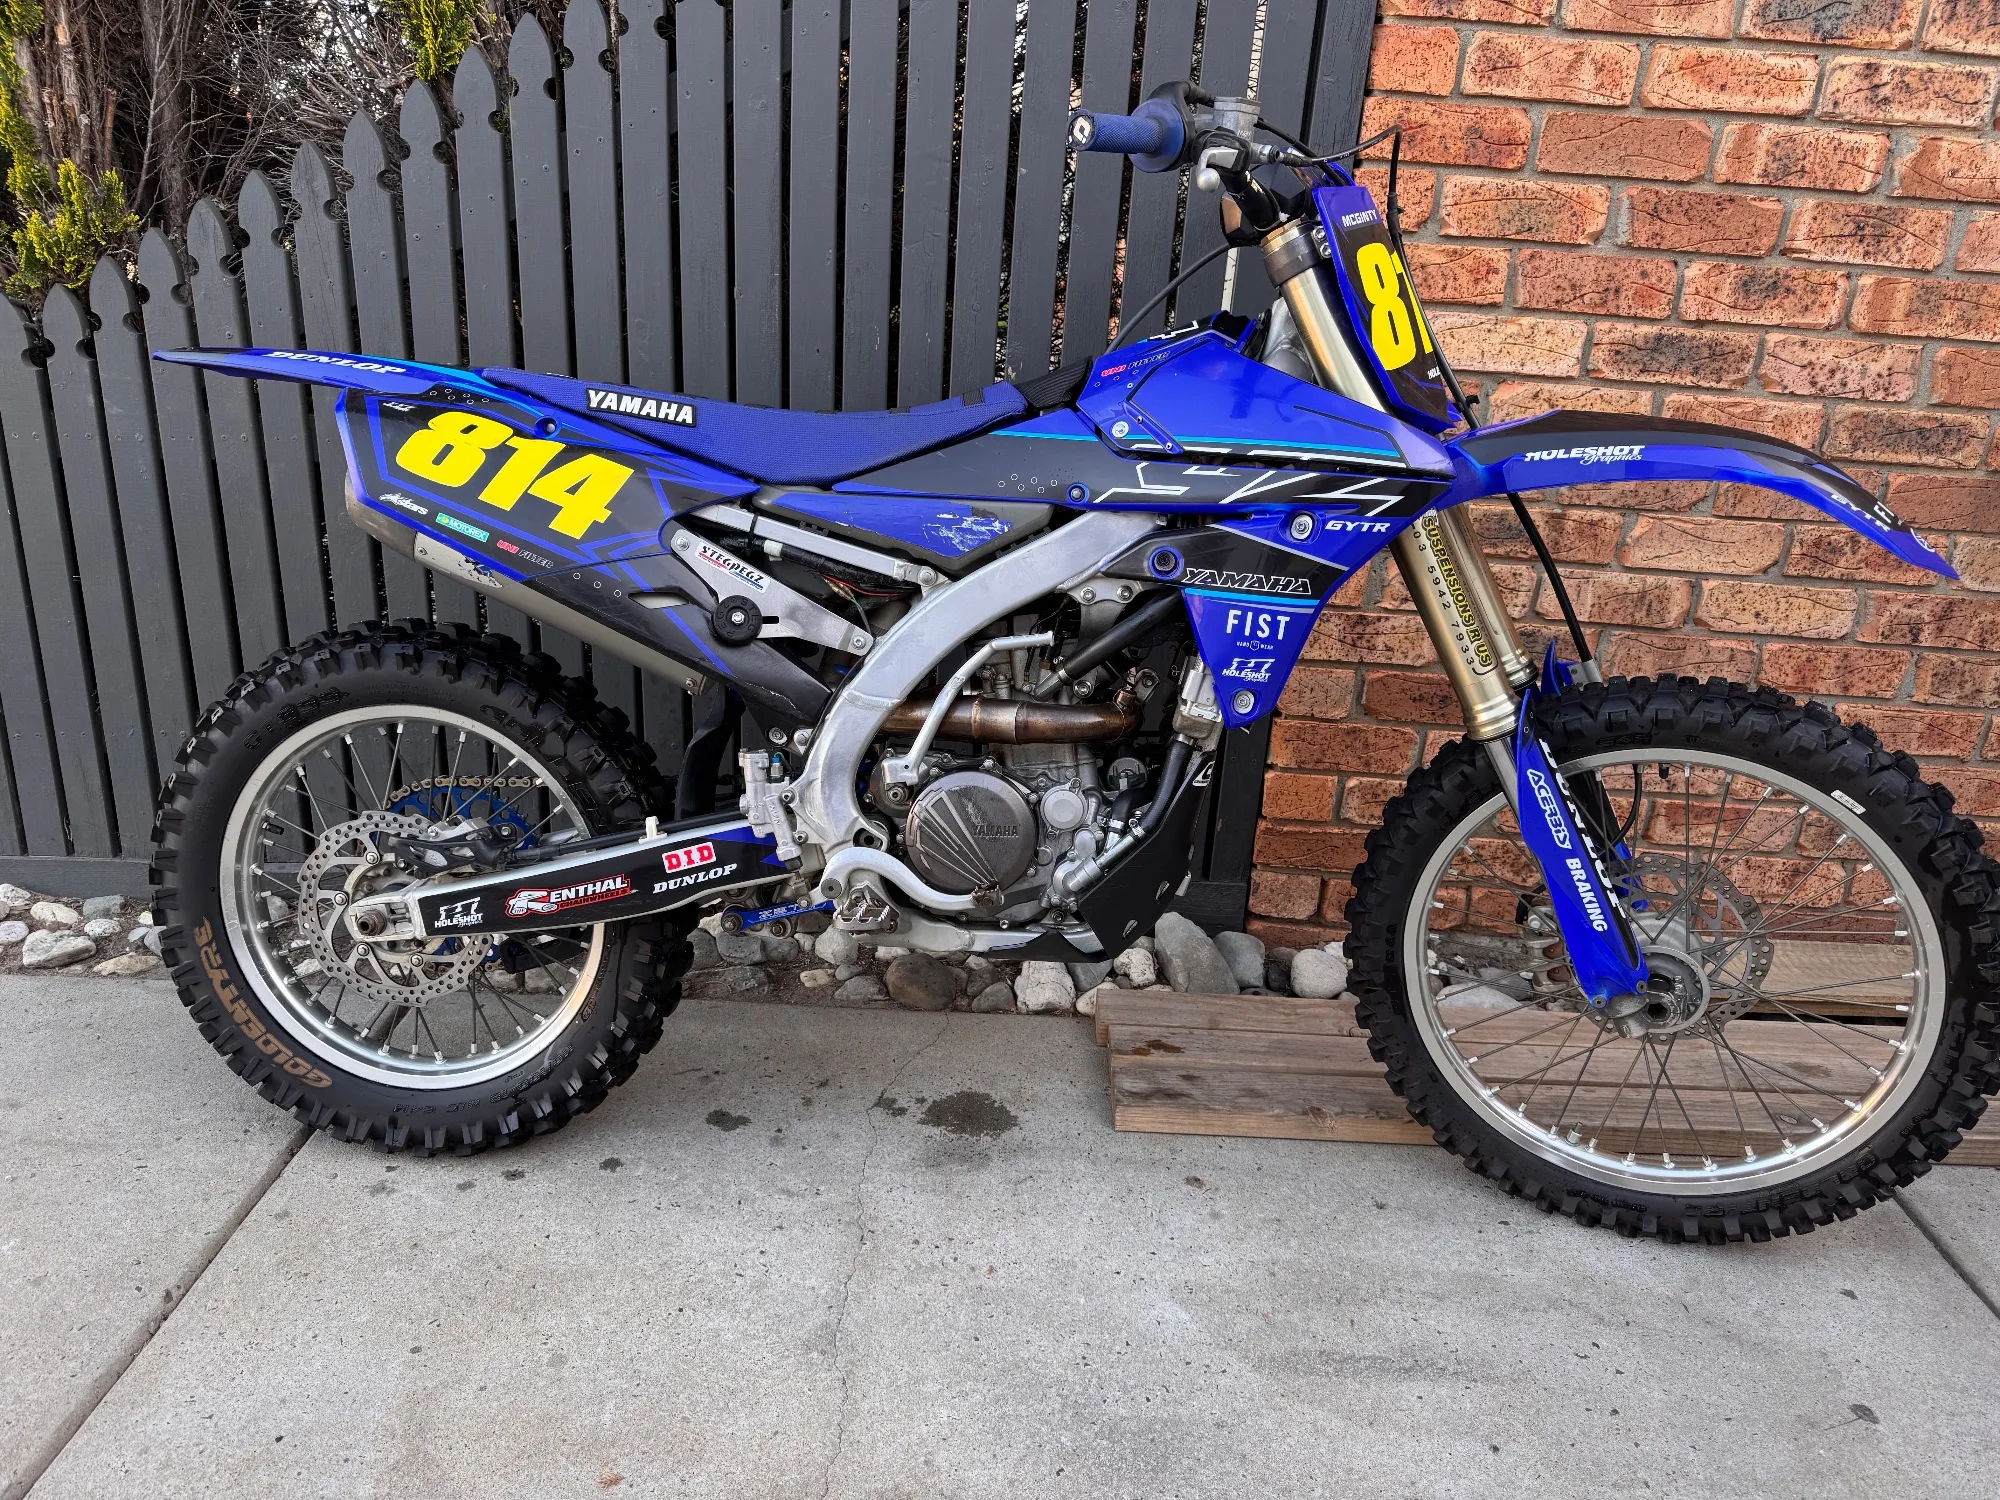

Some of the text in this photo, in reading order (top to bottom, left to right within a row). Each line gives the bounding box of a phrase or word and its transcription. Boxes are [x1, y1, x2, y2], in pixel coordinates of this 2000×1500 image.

[1341, 209, 1378, 228] MCGINTY
[261, 351, 406, 374] DUNLOP
[588, 389, 693, 424] YAMAHA
[1524, 445, 1645, 462] HOLESHOT
[395, 411, 634, 540] 814
[449, 519, 486, 540] MOTOREX
[1325, 519, 1390, 533] GYTR
[497, 539, 520, 554] UNI
[1182, 567, 1311, 595] YAMAHA
[1422, 516, 1476, 628] SUSPENSIONS
[1474, 644, 1492, 667] US
[1226, 609, 1290, 640] FIST
[1222, 668, 1271, 680] HOLESHOT
[973, 824, 1019, 838] YAMAHA
[665, 844, 714, 871] D.I.D
[653, 863, 737, 894] DUNLOP
[1566, 858, 1608, 932] BRAKING
[434, 912, 484, 928] HOLESHOT
